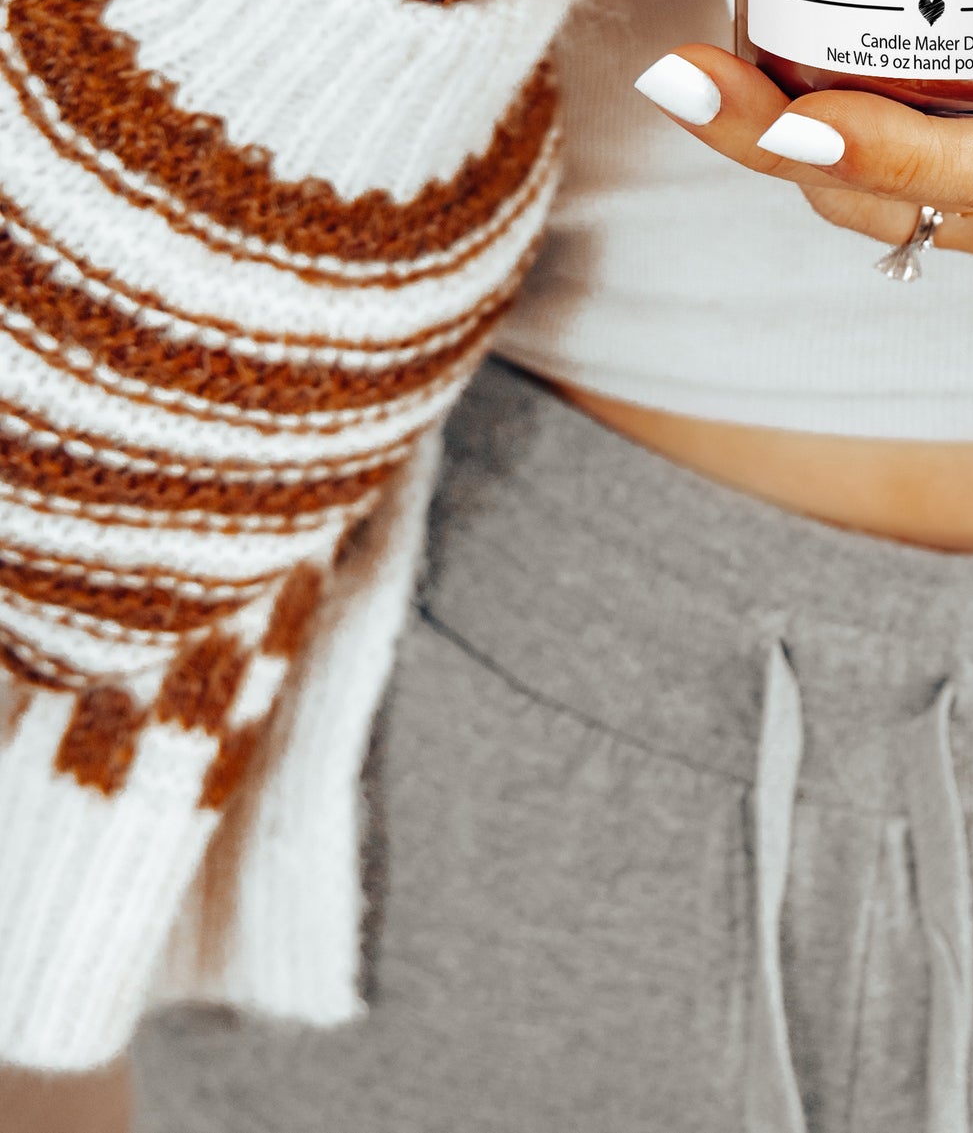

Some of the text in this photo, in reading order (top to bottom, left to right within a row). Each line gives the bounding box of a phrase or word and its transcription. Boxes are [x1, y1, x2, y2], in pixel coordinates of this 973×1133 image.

[861, 33, 910, 50] Candle
[916, 36, 960, 50] Maker
[828, 47, 850, 64] Net
[853, 51, 876, 66] Wt.
[880, 54, 888, 67] 9
[893, 58, 910, 69] oz
[914, 55, 950, 70] hand
